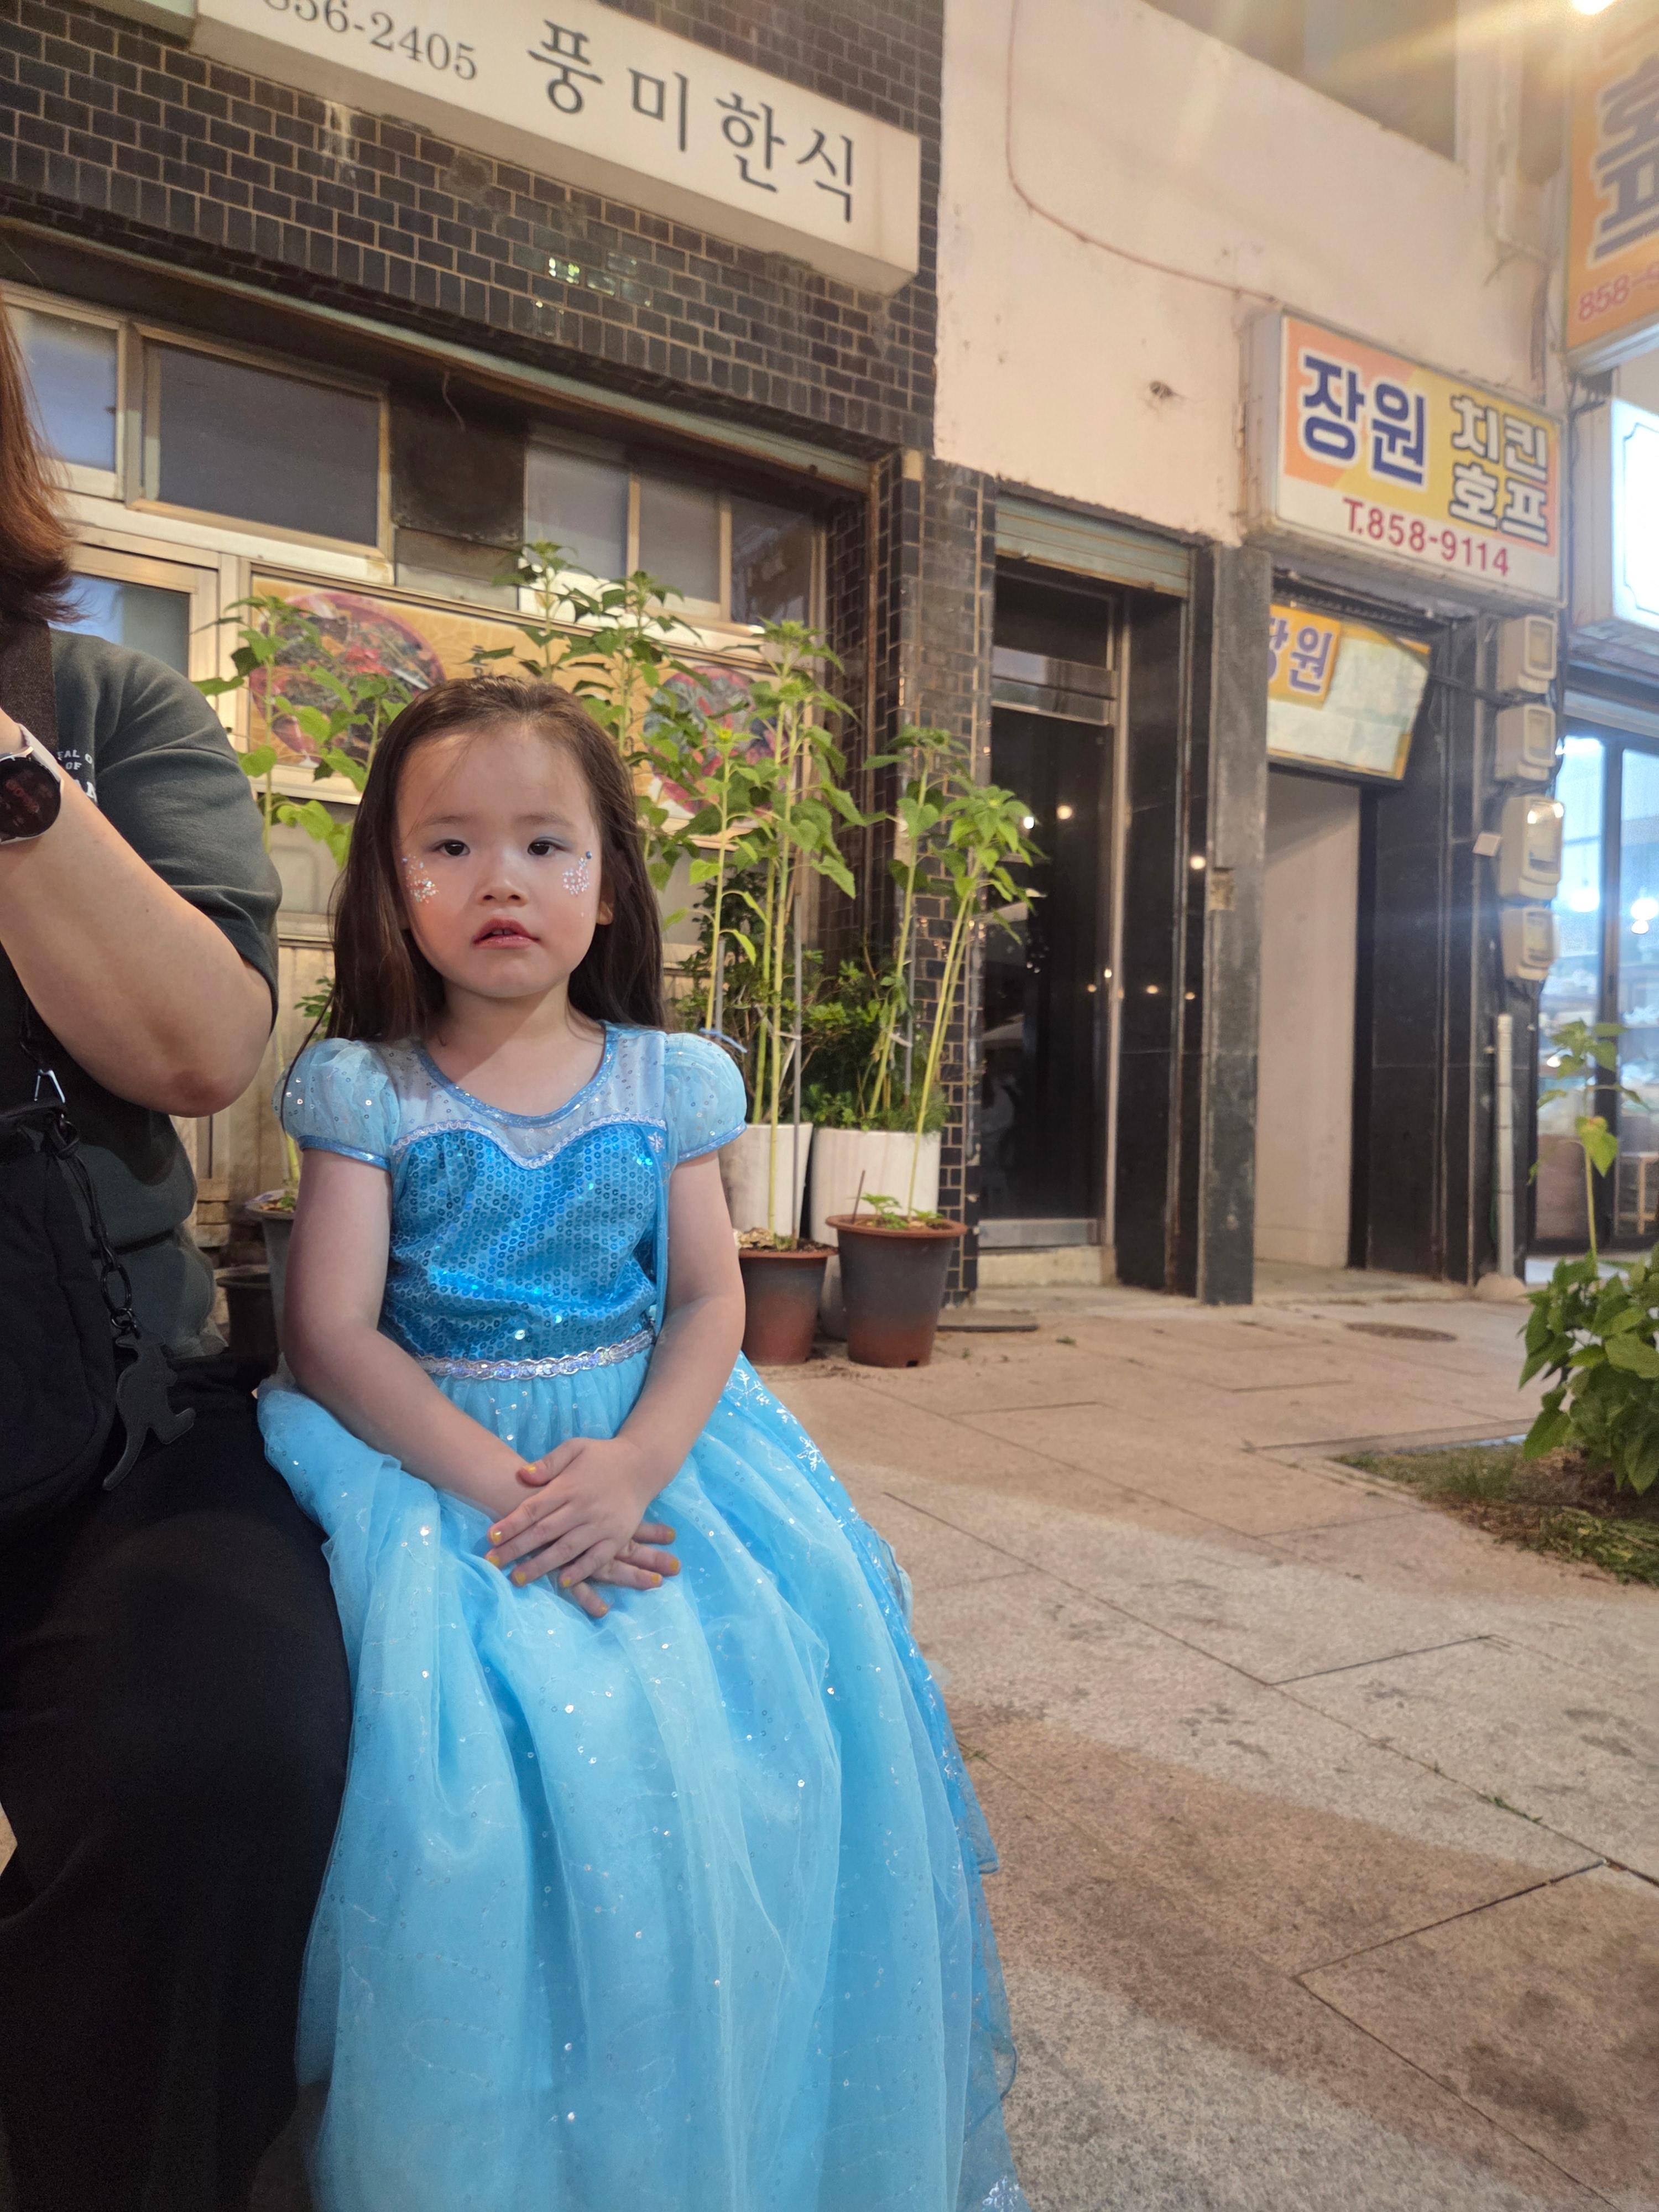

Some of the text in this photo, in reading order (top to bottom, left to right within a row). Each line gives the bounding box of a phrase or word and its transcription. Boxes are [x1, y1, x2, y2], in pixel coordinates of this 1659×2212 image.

[527, 19, 854, 222] 풍미한식
[1303, 354, 1425, 486] 장원
[1451, 394, 1548, 484] 치킨
[1342, 497, 1510, 577] T.858-9114
[1448, 462, 1549, 546] 호프
[66, 761, 82, 770] OF
